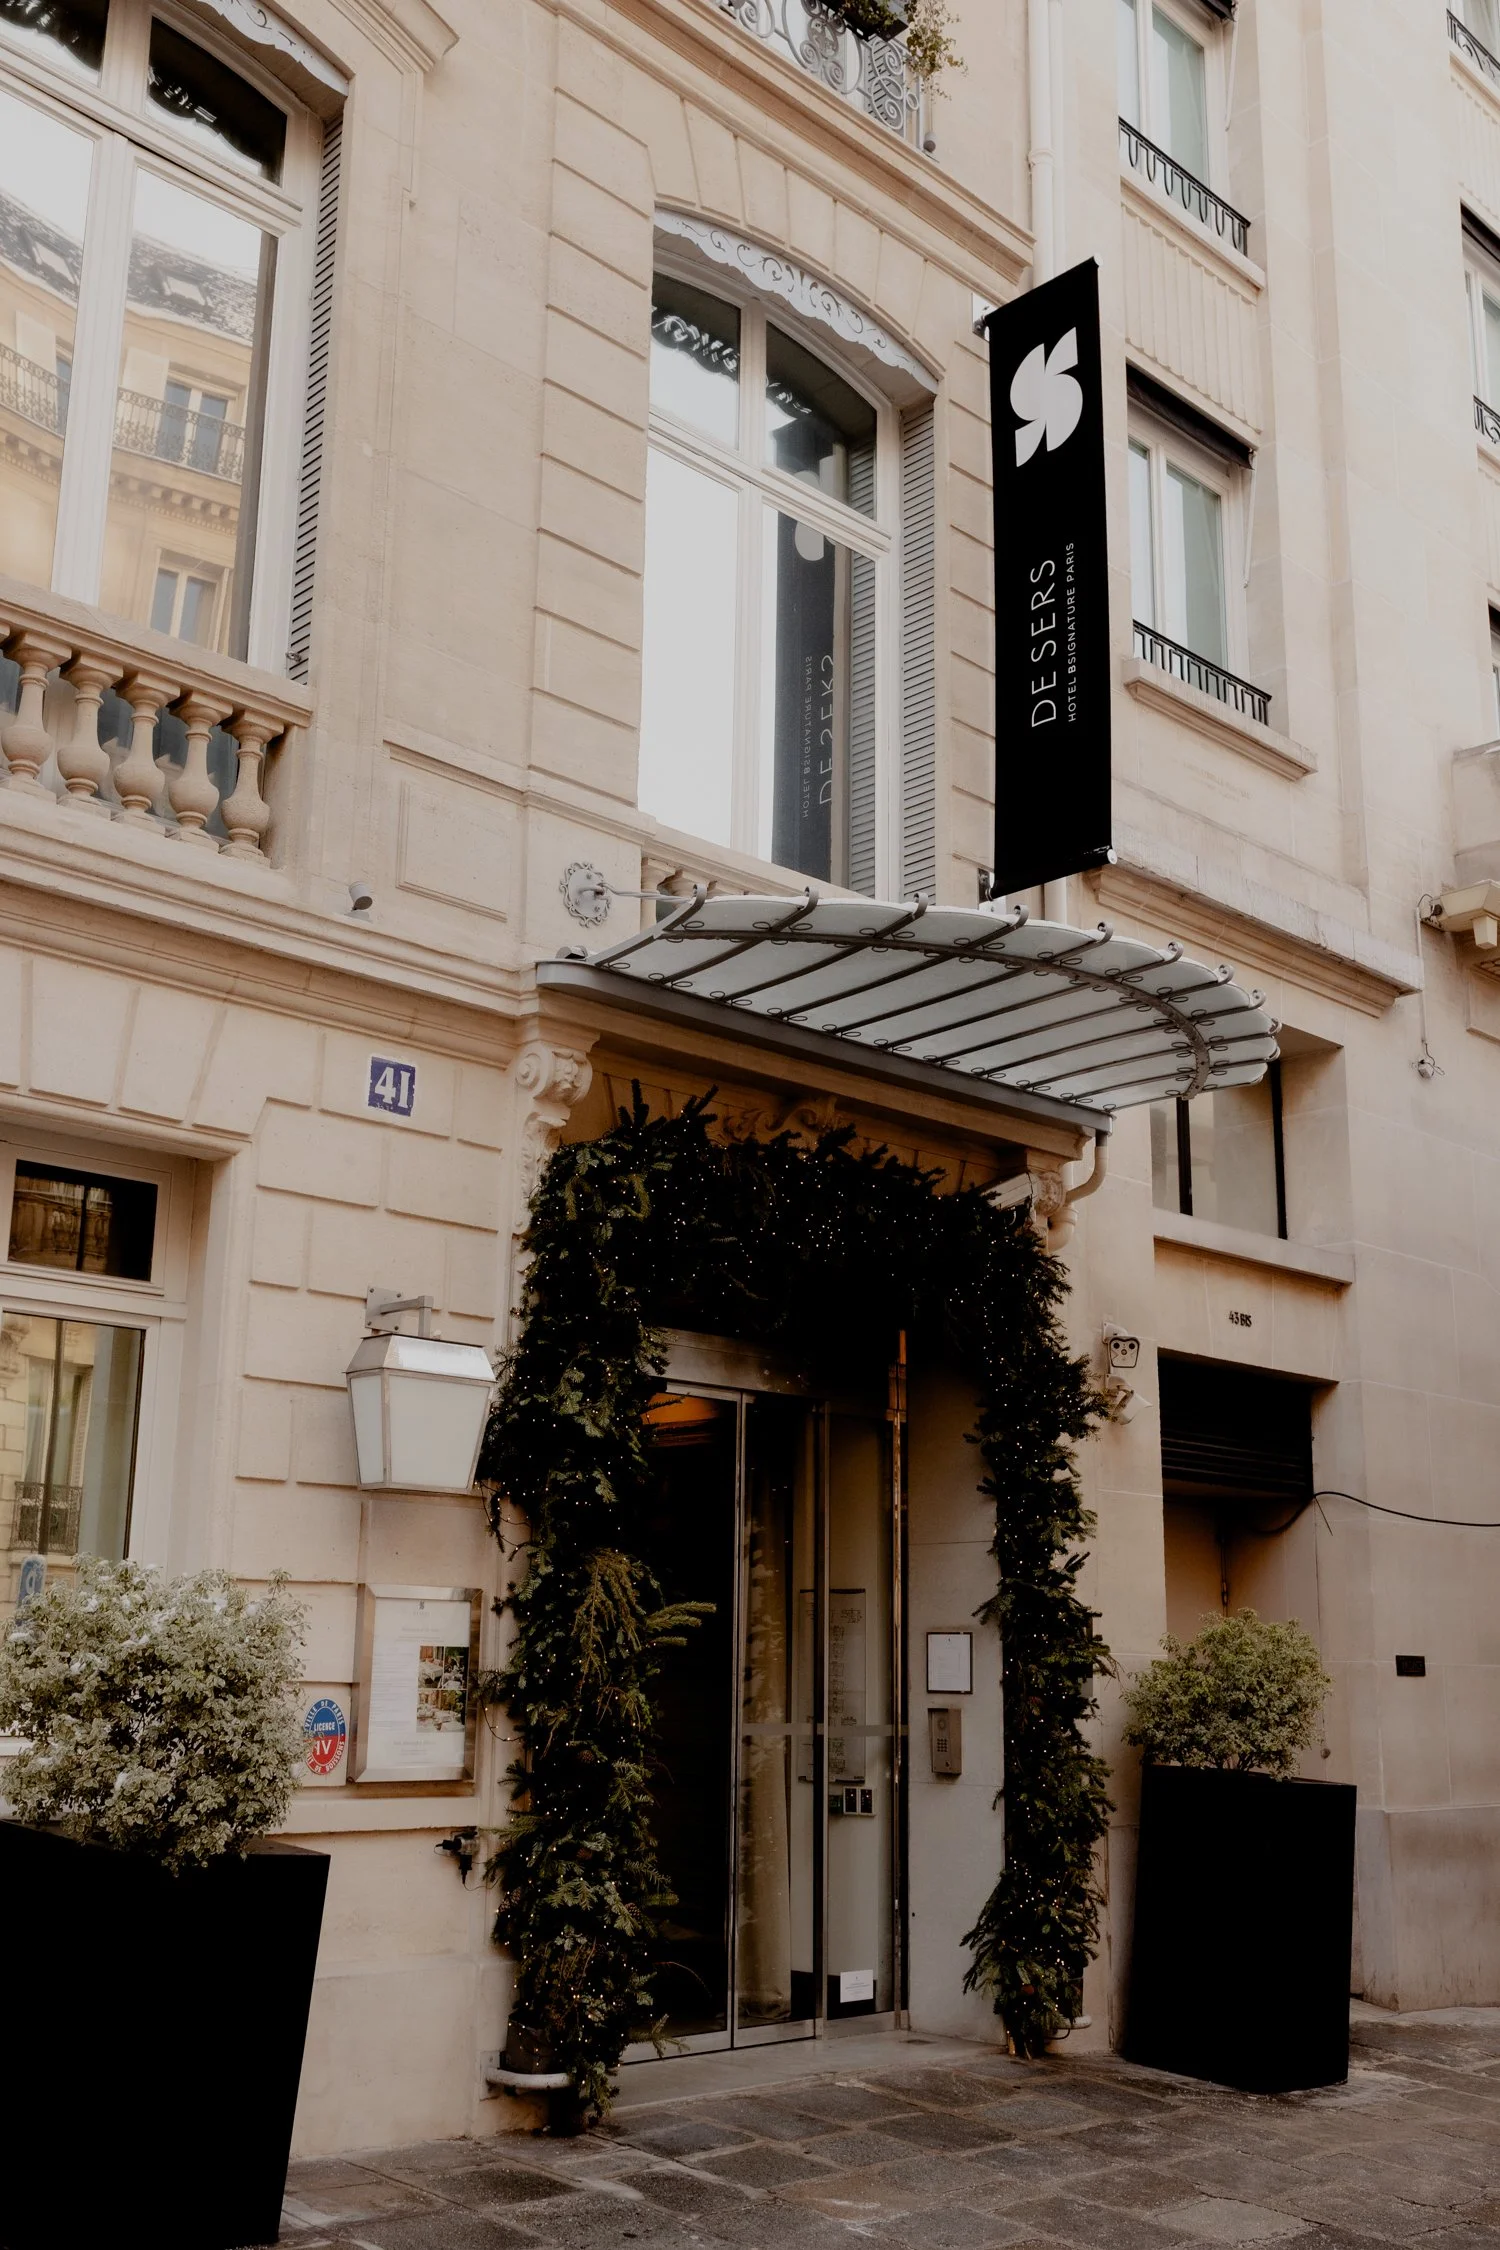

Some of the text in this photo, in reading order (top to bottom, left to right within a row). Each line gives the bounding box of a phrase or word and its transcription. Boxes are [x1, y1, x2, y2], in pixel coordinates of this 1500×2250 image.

[1030, 560, 1057, 728] DE SERS
[1065, 542, 1077, 722] HOTEL BSIGNATURE PARIS
[374, 1066, 411, 1109] 41
[1228, 1310, 1252, 1327] 43 BIS
[305, 1705, 318, 1728] VILLE
[332, 1703, 345, 1725] PARIS
[313, 1722, 336, 1731] LICENCE
[315, 1739, 332, 1756] IV
[325, 1741, 345, 1772] BOISSONS
